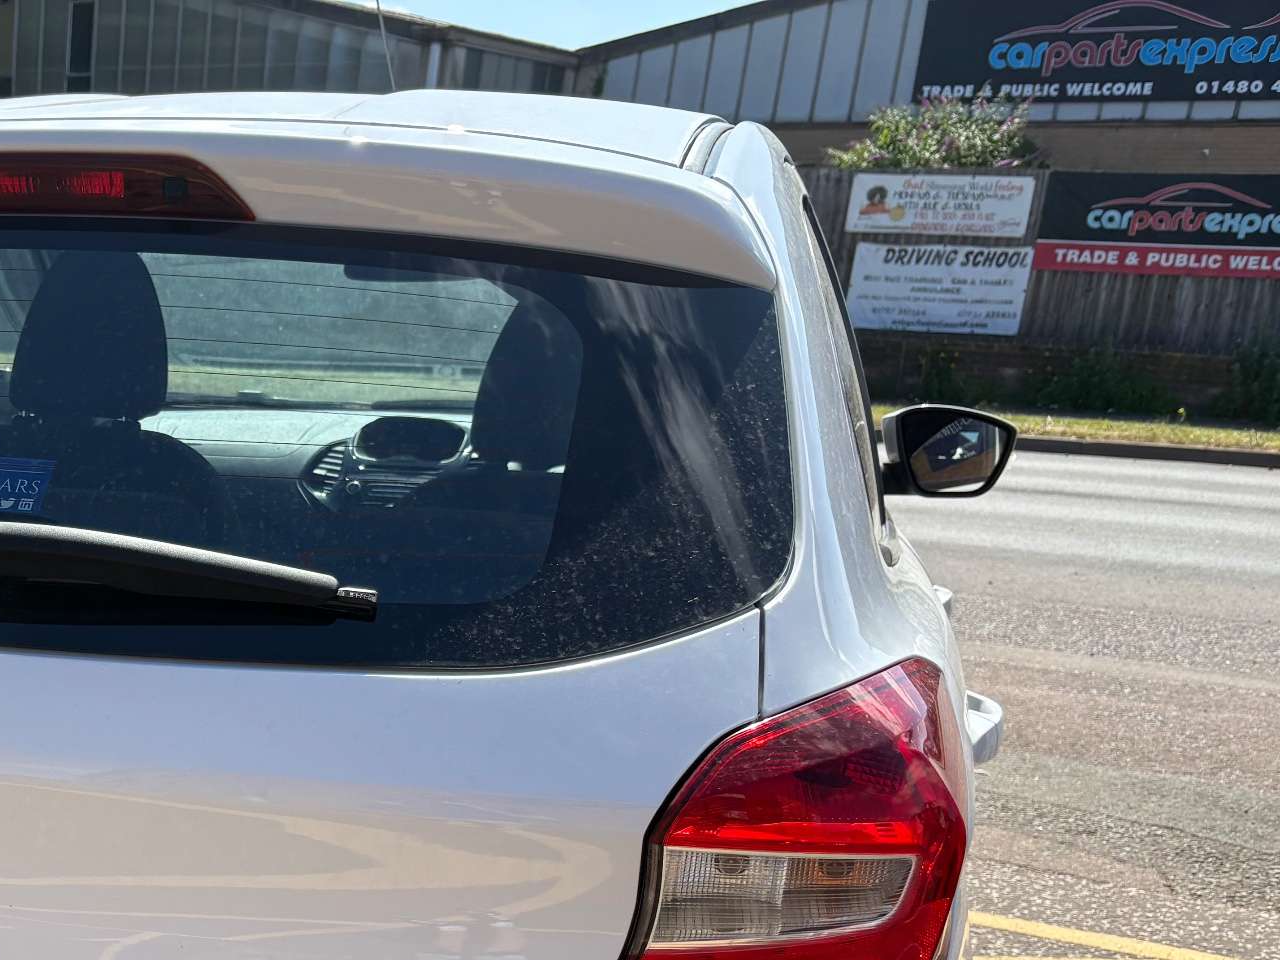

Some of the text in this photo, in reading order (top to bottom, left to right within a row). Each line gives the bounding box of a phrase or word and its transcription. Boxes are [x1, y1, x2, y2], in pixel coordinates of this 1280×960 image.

[922, 84, 974, 98] TRADE
[1000, 82, 1060, 97] PUBLIC
[1066, 81, 1154, 96] WELCOME
[1195, 80, 1263, 95] 01480
[883, 247, 1029, 269] DRIVING SCHOOL
[1055, 248, 1280, 271] TRADE & PUBLIC WELC
